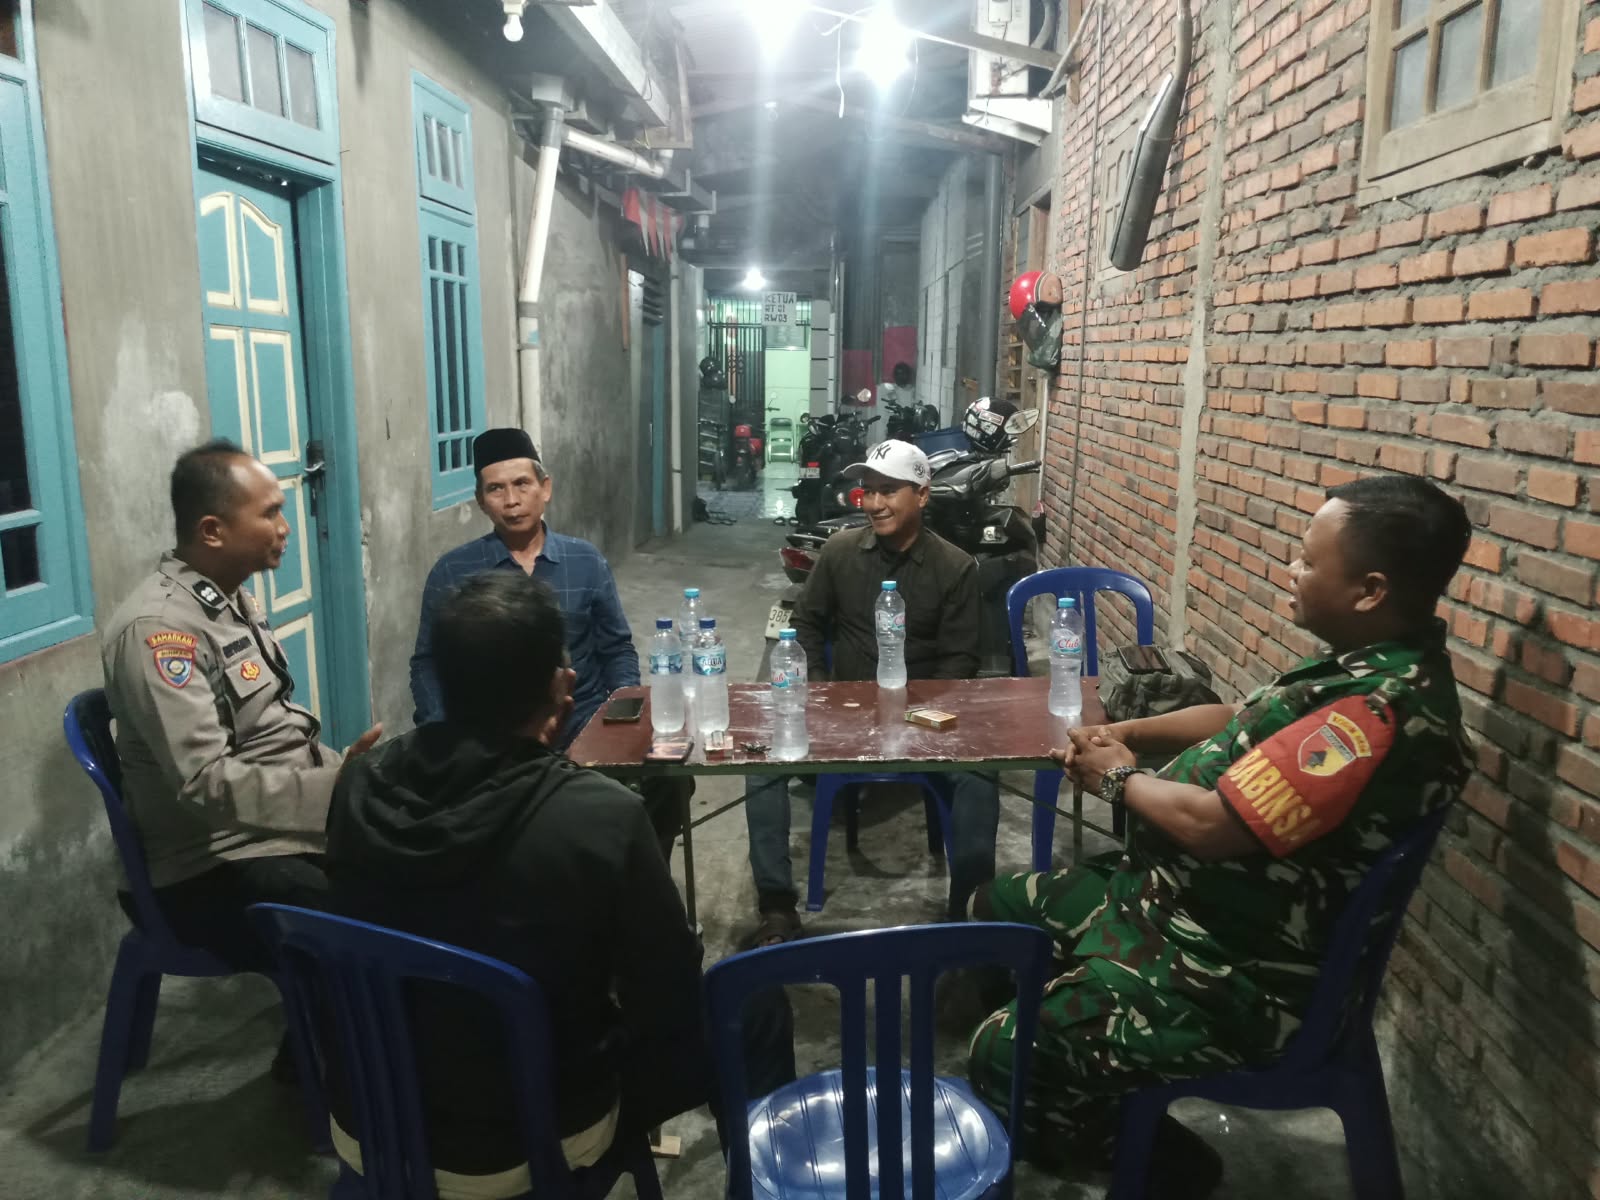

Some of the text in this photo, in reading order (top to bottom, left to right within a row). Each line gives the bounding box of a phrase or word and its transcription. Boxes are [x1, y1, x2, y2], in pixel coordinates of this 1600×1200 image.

[765, 293, 794, 304] KETUA
[765, 304, 775, 313] RT
[703, 656, 723, 666] AQUA
